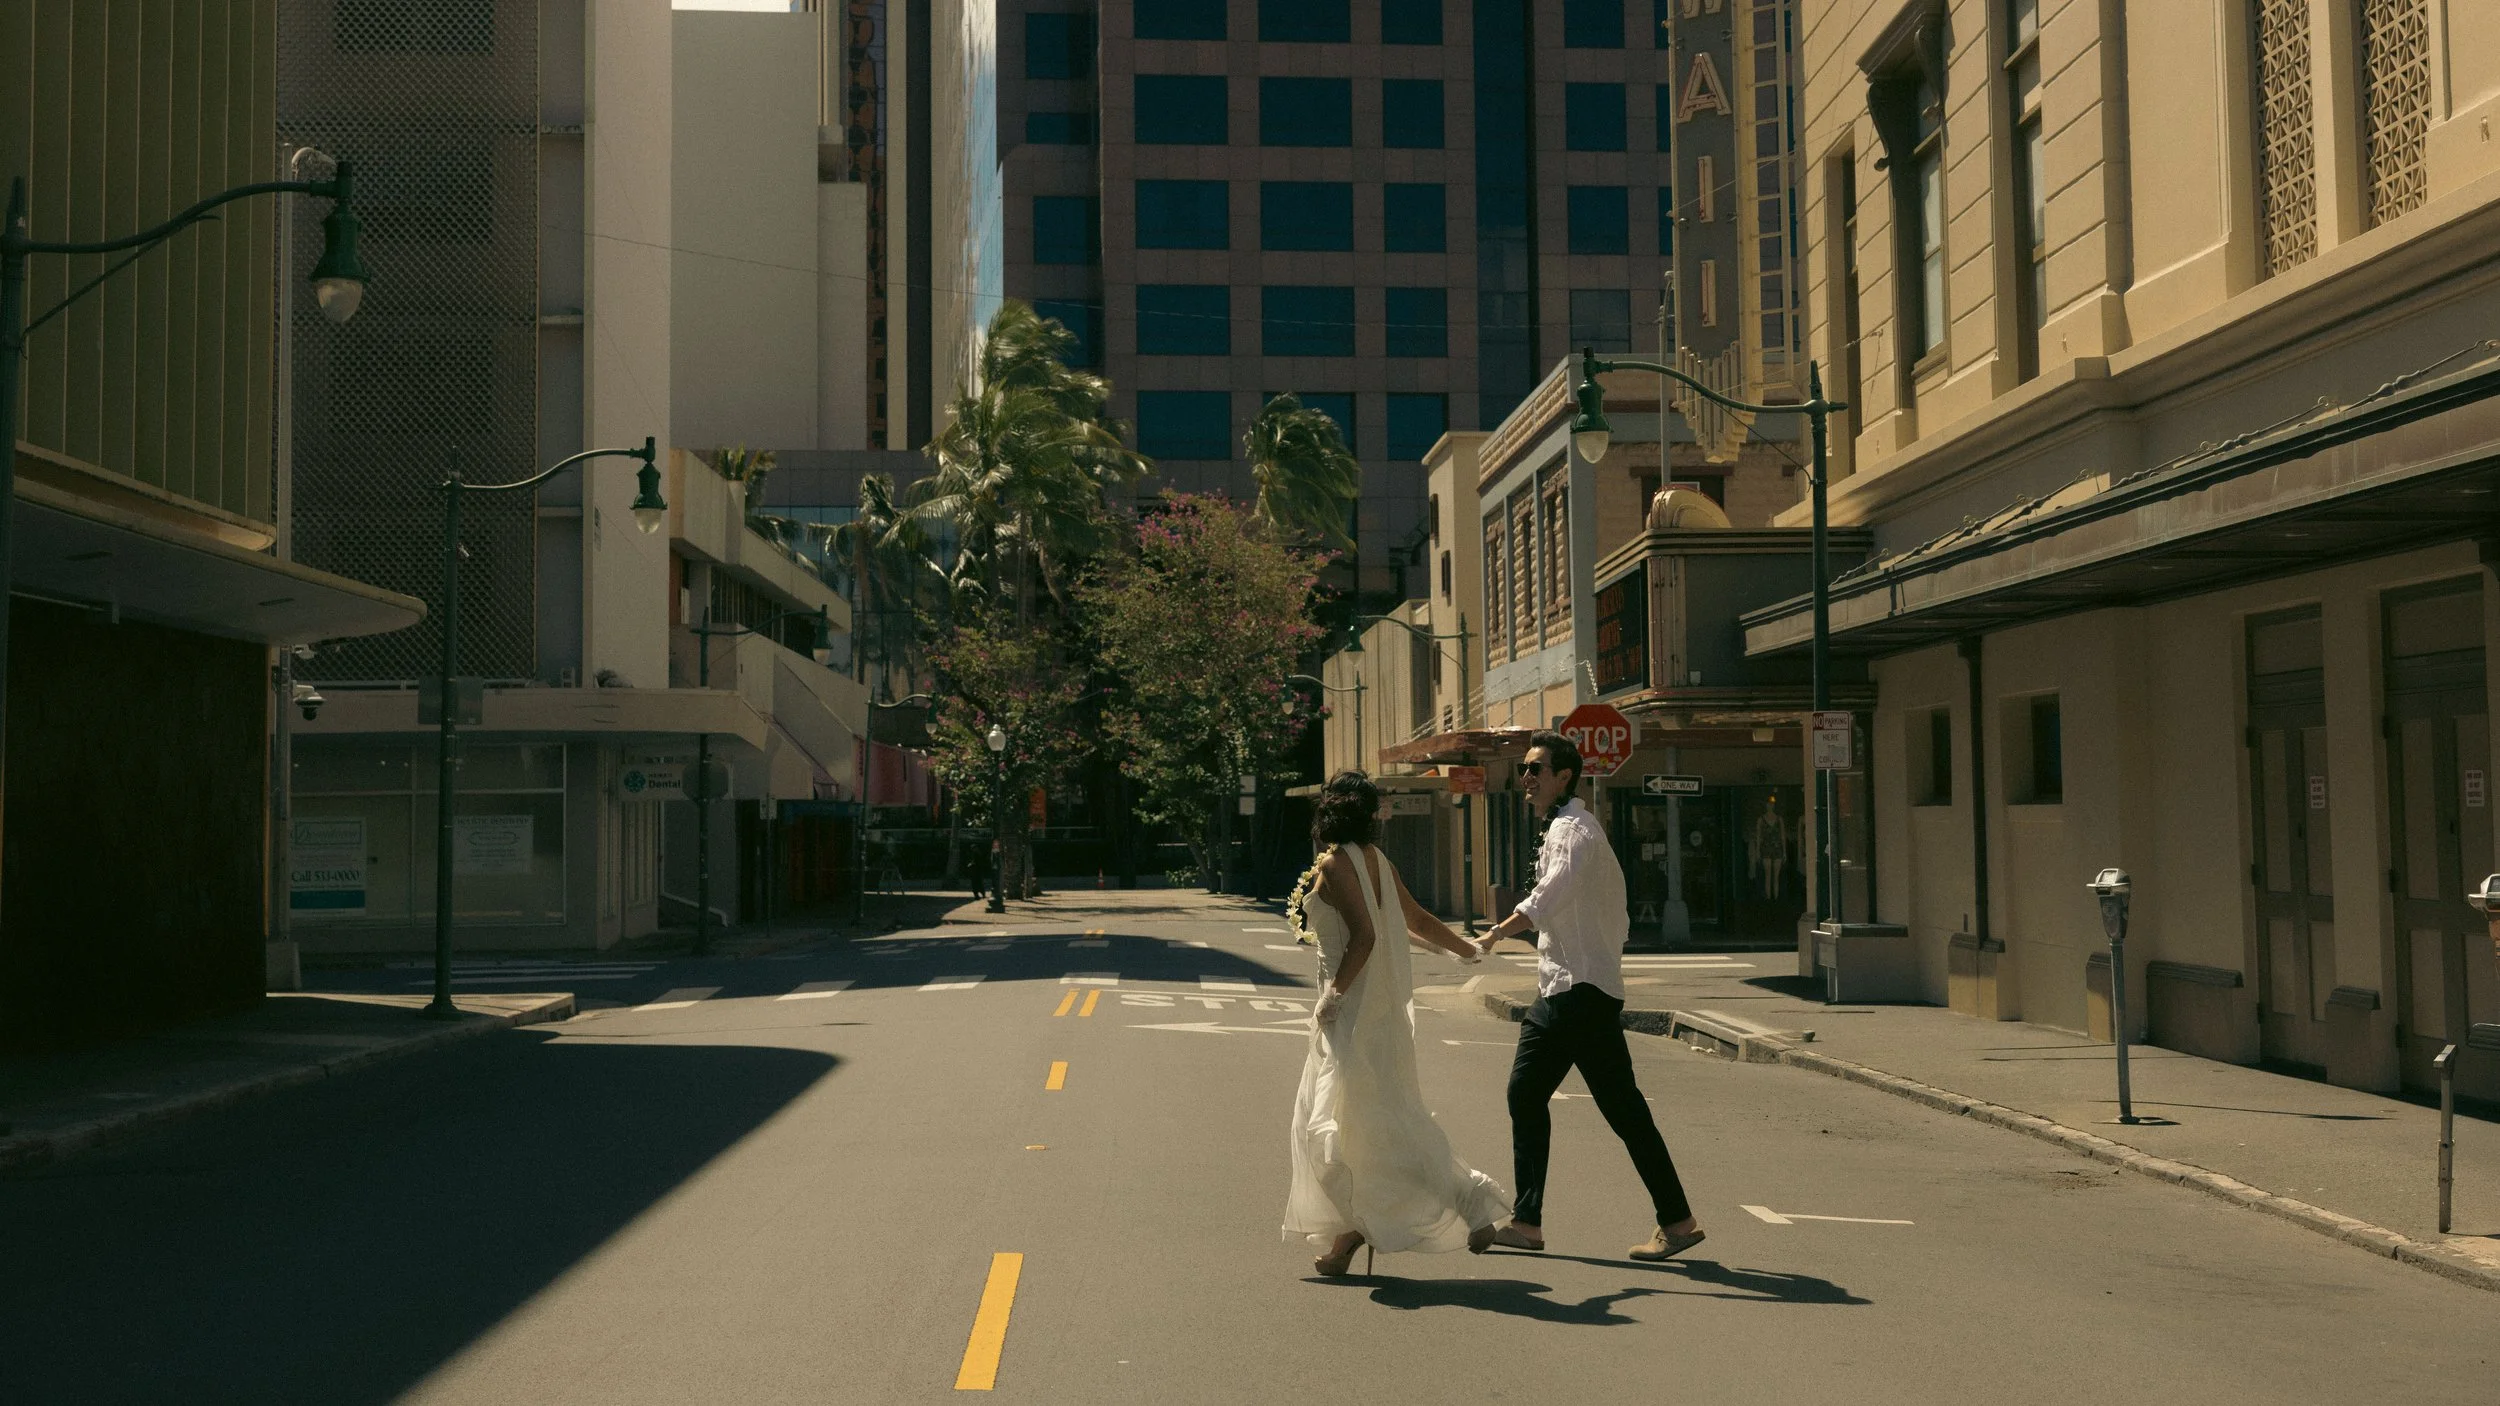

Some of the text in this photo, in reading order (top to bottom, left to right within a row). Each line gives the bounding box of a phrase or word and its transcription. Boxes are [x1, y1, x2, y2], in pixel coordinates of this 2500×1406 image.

[1677, 0, 1733, 328] AII
[1812, 715, 1848, 729] NO PARKING
[1565, 726, 1628, 754] STOP
[1822, 733, 1840, 742] HERE
[648, 779, 681, 789] Dental
[1660, 781, 1697, 790] ONE WAY
[291, 869, 312, 882] Call
